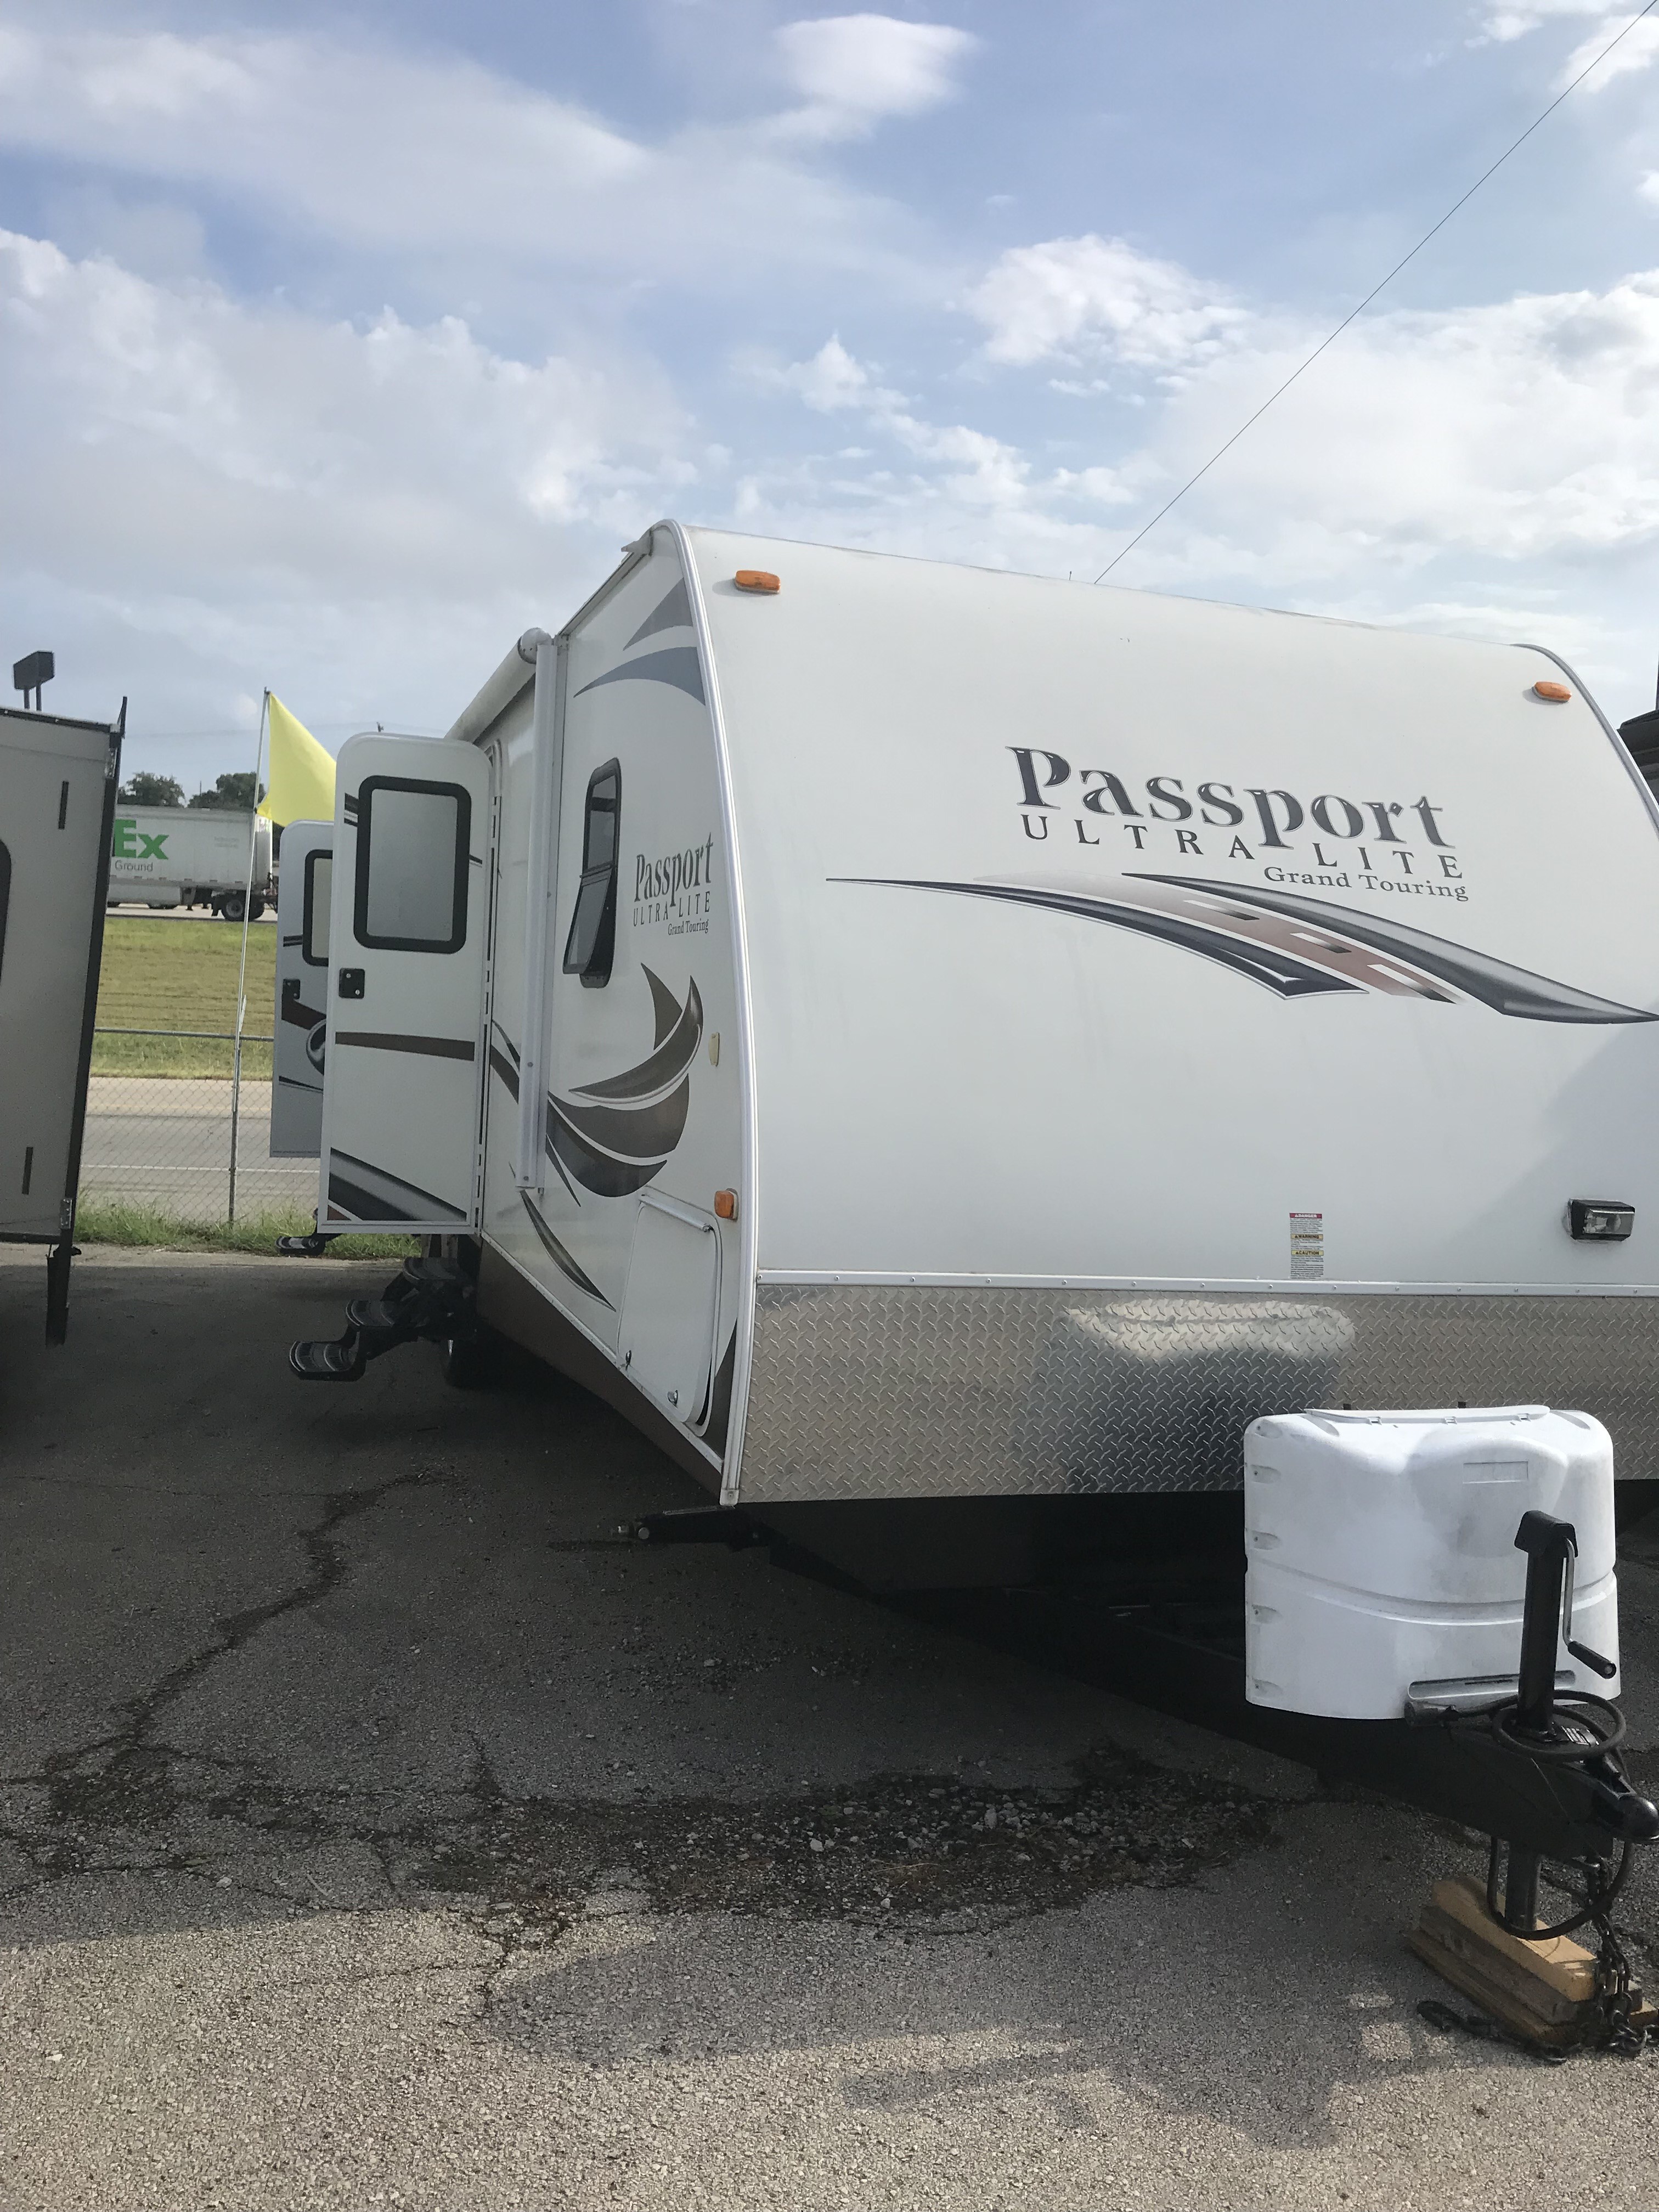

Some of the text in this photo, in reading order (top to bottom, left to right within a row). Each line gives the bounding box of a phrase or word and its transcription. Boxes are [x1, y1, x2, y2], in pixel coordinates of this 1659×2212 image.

[1005, 746, 1457, 850] Passport
[112, 819, 170, 860] Ex
[1020, 814, 1463, 879] ULTRA LITE
[114, 860, 154, 872] Ground
[634, 831, 714, 908] Passport
[1263, 866, 1470, 902] Grand Touring
[633, 890, 710, 927] ULTRA LITE
[668, 918, 709, 936] Grand Touring
